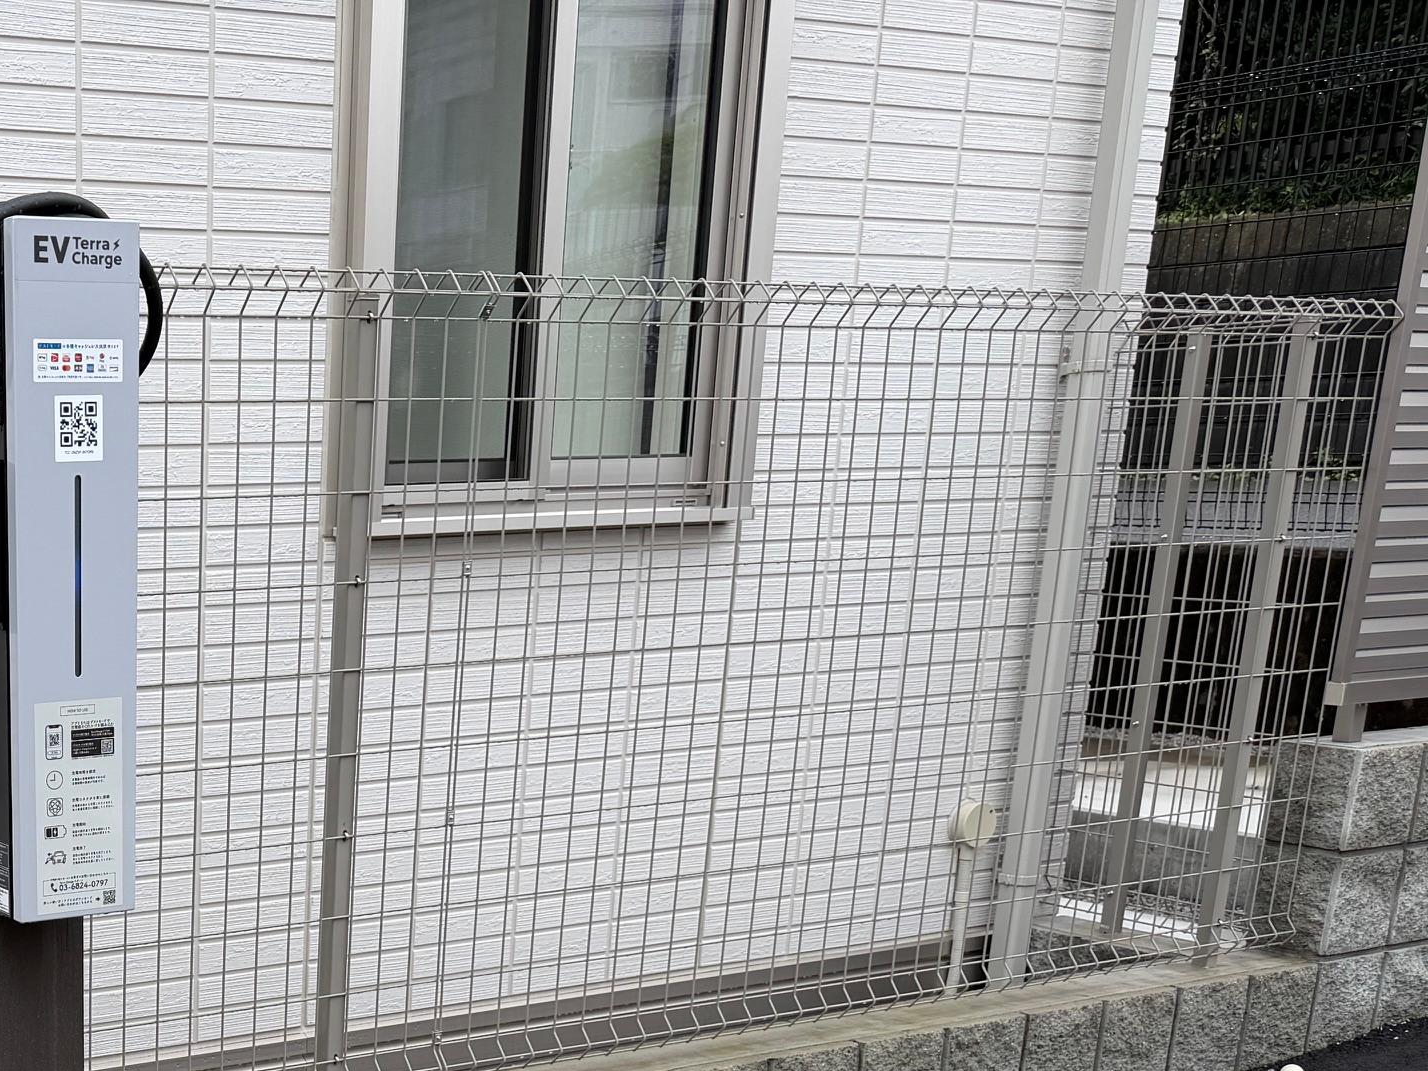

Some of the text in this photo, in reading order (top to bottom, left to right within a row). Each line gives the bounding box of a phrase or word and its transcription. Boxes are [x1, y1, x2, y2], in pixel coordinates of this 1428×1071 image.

[34, 235, 71, 264] EV
[72, 236, 110, 250] Terra
[72, 252, 123, 269] Charge
[59, 879, 108, 891] 03-6824-0797
